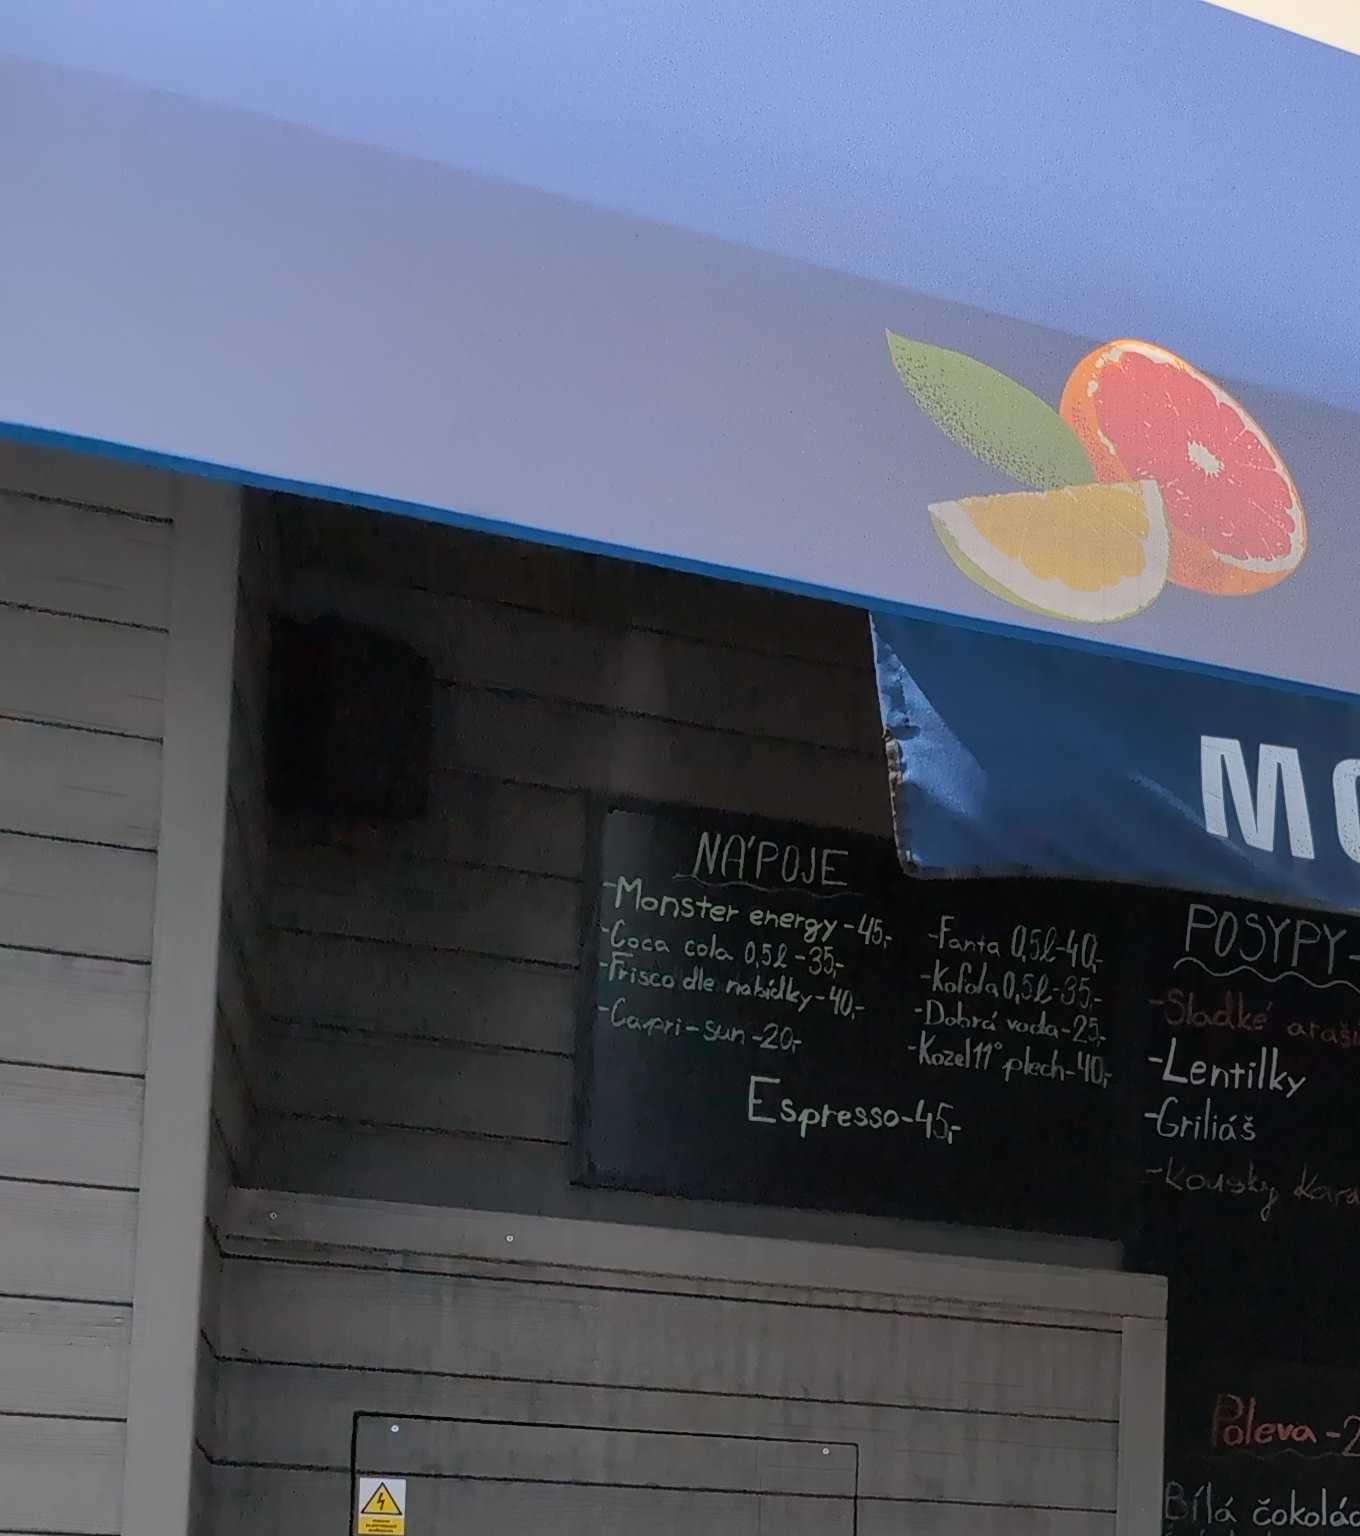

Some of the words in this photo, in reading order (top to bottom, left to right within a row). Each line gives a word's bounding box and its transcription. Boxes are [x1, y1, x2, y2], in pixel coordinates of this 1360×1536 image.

[693, 831, 848, 887] NÁPOJE
[750, 910, 838, 943] energy
[684, 935, 734, 961] cola
[682, 967, 715, 991] dle
[1211, 1393, 1317, 1448] Poleva
[1164, 1480, 1237, 1524] Bílá
